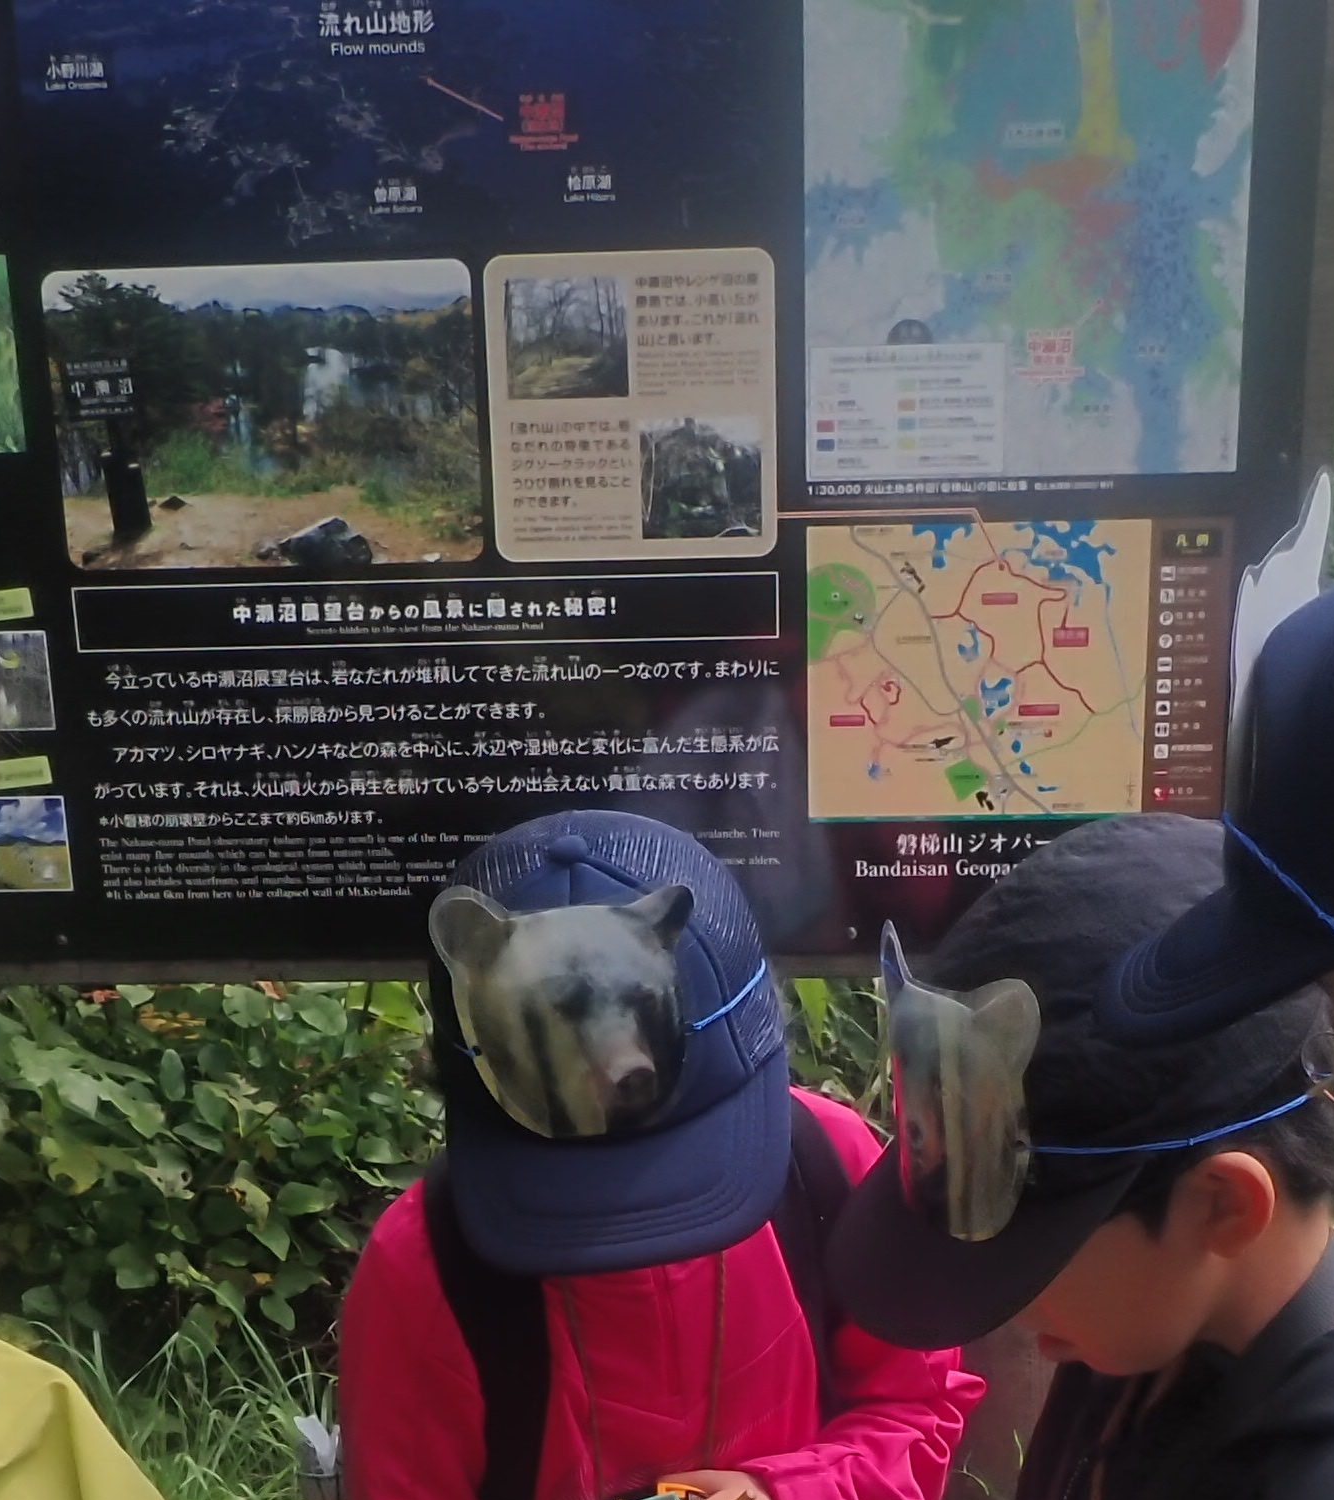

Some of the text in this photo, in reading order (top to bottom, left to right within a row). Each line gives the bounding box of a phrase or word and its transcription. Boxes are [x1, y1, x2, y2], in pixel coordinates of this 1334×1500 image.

[319, 10, 434, 37] 流れ山地形
[331, 40, 425, 56] Flow mounds
[407, 832, 417, 843] of
[421, 831, 436, 842] the
[439, 831, 458, 842] flow
[463, 830, 495, 842] mound
[697, 829, 748, 839] avalanche.
[751, 828, 780, 838] There
[897, 833, 1052, 855] 磐梯山ジオパー
[855, 858, 1019, 884] Bandaisan Geopa
[135, 890, 159, 900] about
[187, 889, 208, 899] from
[248, 888, 262, 898] the
[312, 887, 331, 897] wall
